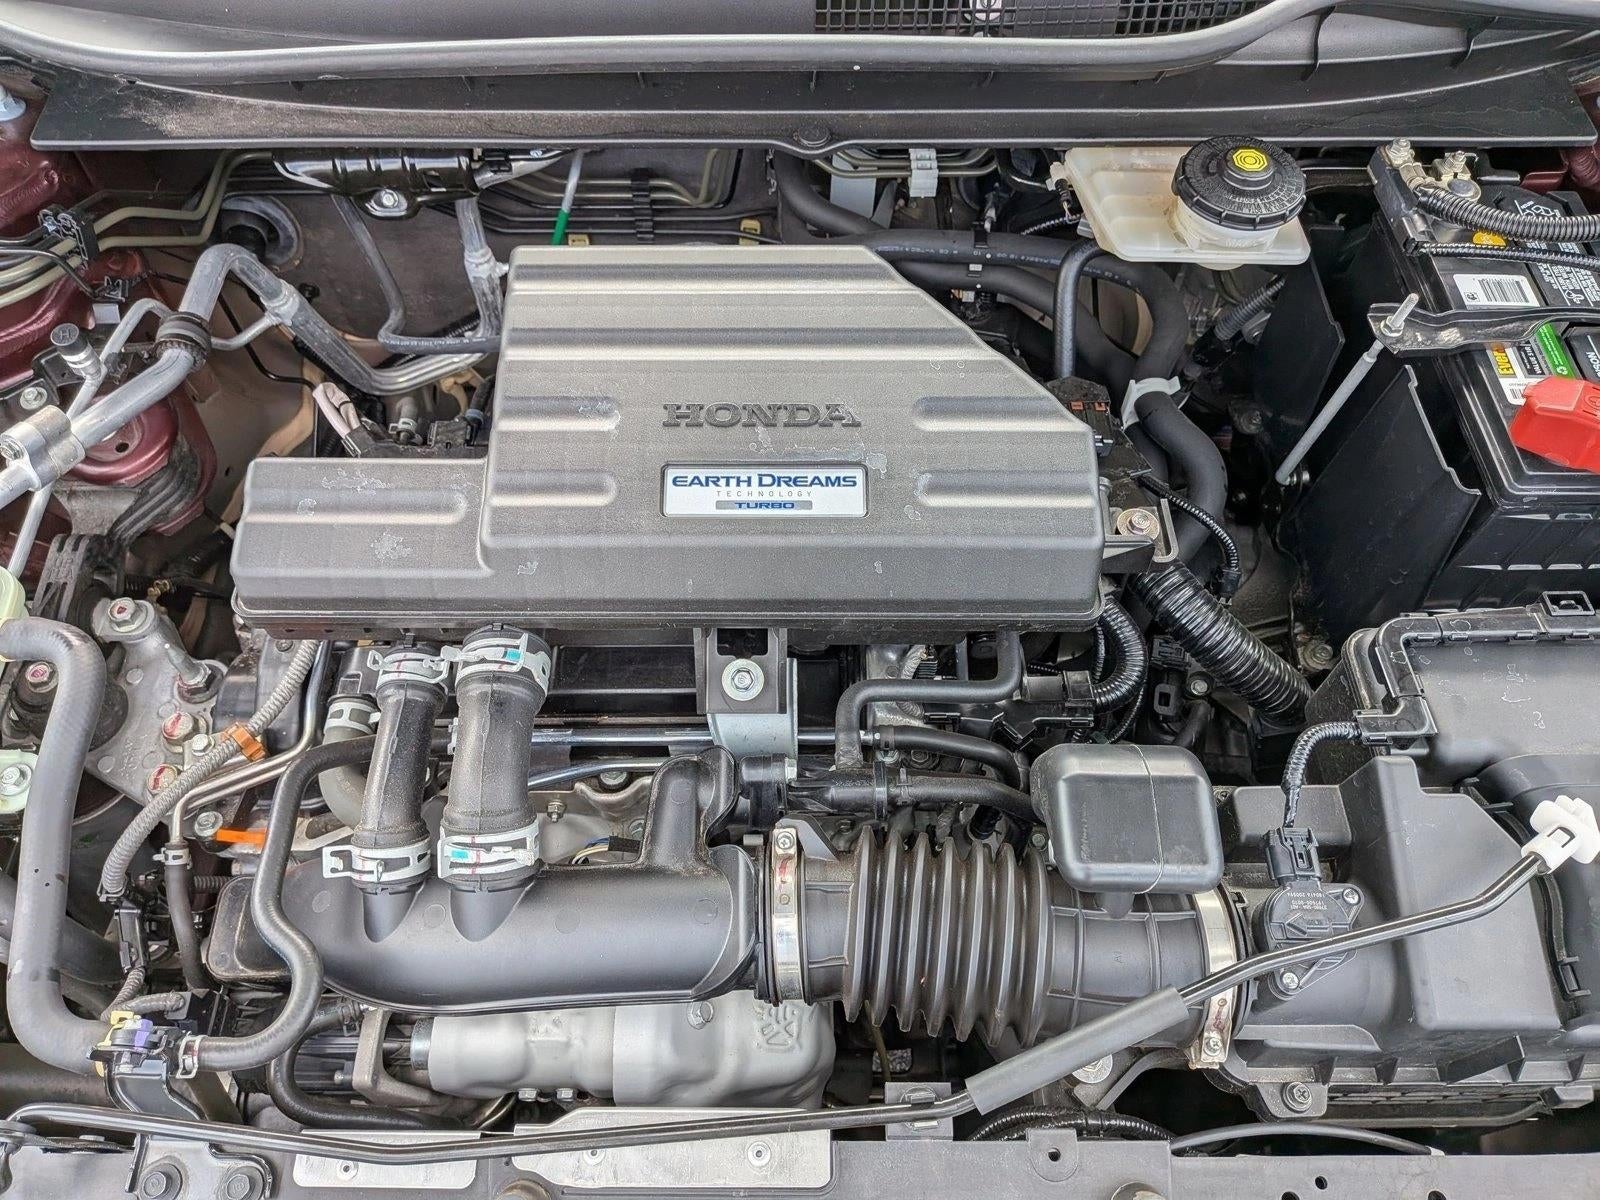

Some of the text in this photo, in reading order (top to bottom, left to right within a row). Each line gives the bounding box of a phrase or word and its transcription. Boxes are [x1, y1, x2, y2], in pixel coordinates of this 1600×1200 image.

[662, 403, 862, 427] HONDA
[672, 474, 857, 488] EARTH DREAMS
